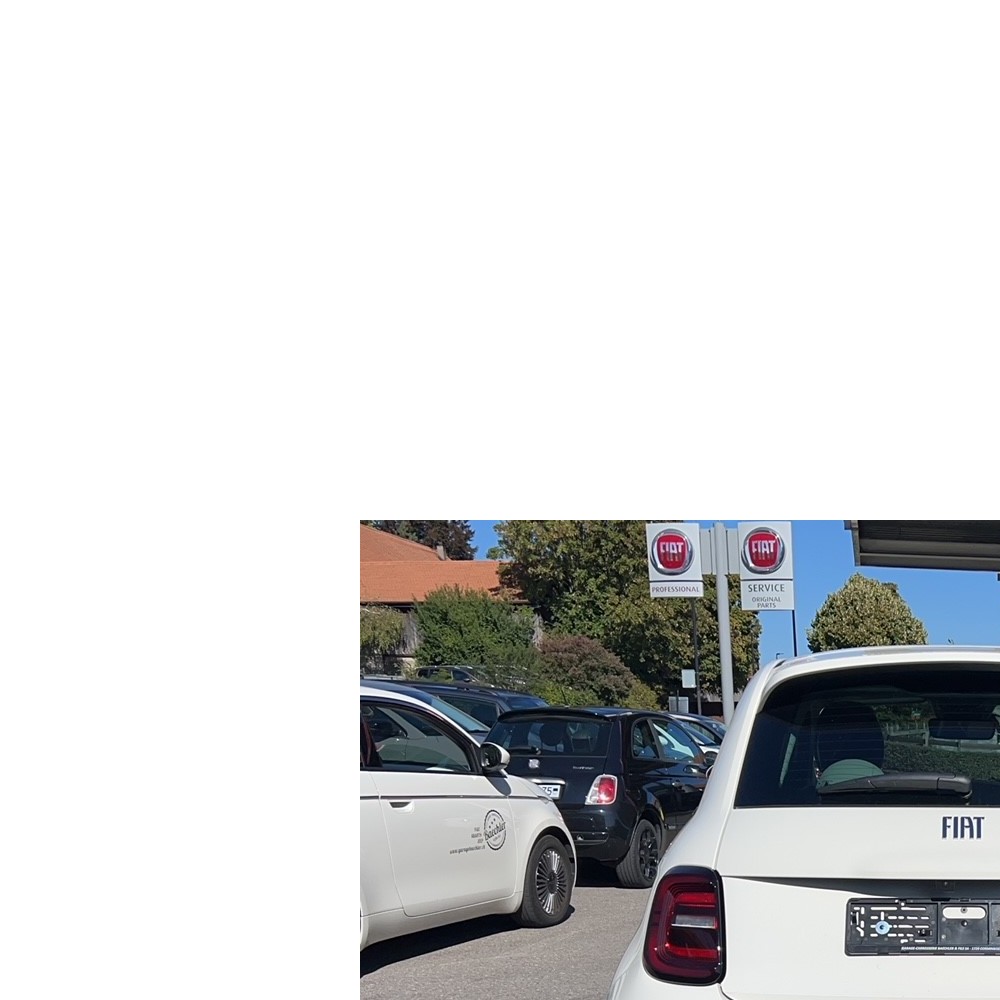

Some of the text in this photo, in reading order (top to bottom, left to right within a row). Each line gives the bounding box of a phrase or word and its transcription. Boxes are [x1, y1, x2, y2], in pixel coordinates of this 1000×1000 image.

[660, 541, 684, 554] FIAT
[752, 540, 776, 554] FIAT
[652, 584, 700, 593] PROFESSIONAL
[748, 583, 785, 592] SERVICE
[483, 821, 506, 841] Baechler
[942, 816, 985, 839] FIAT
